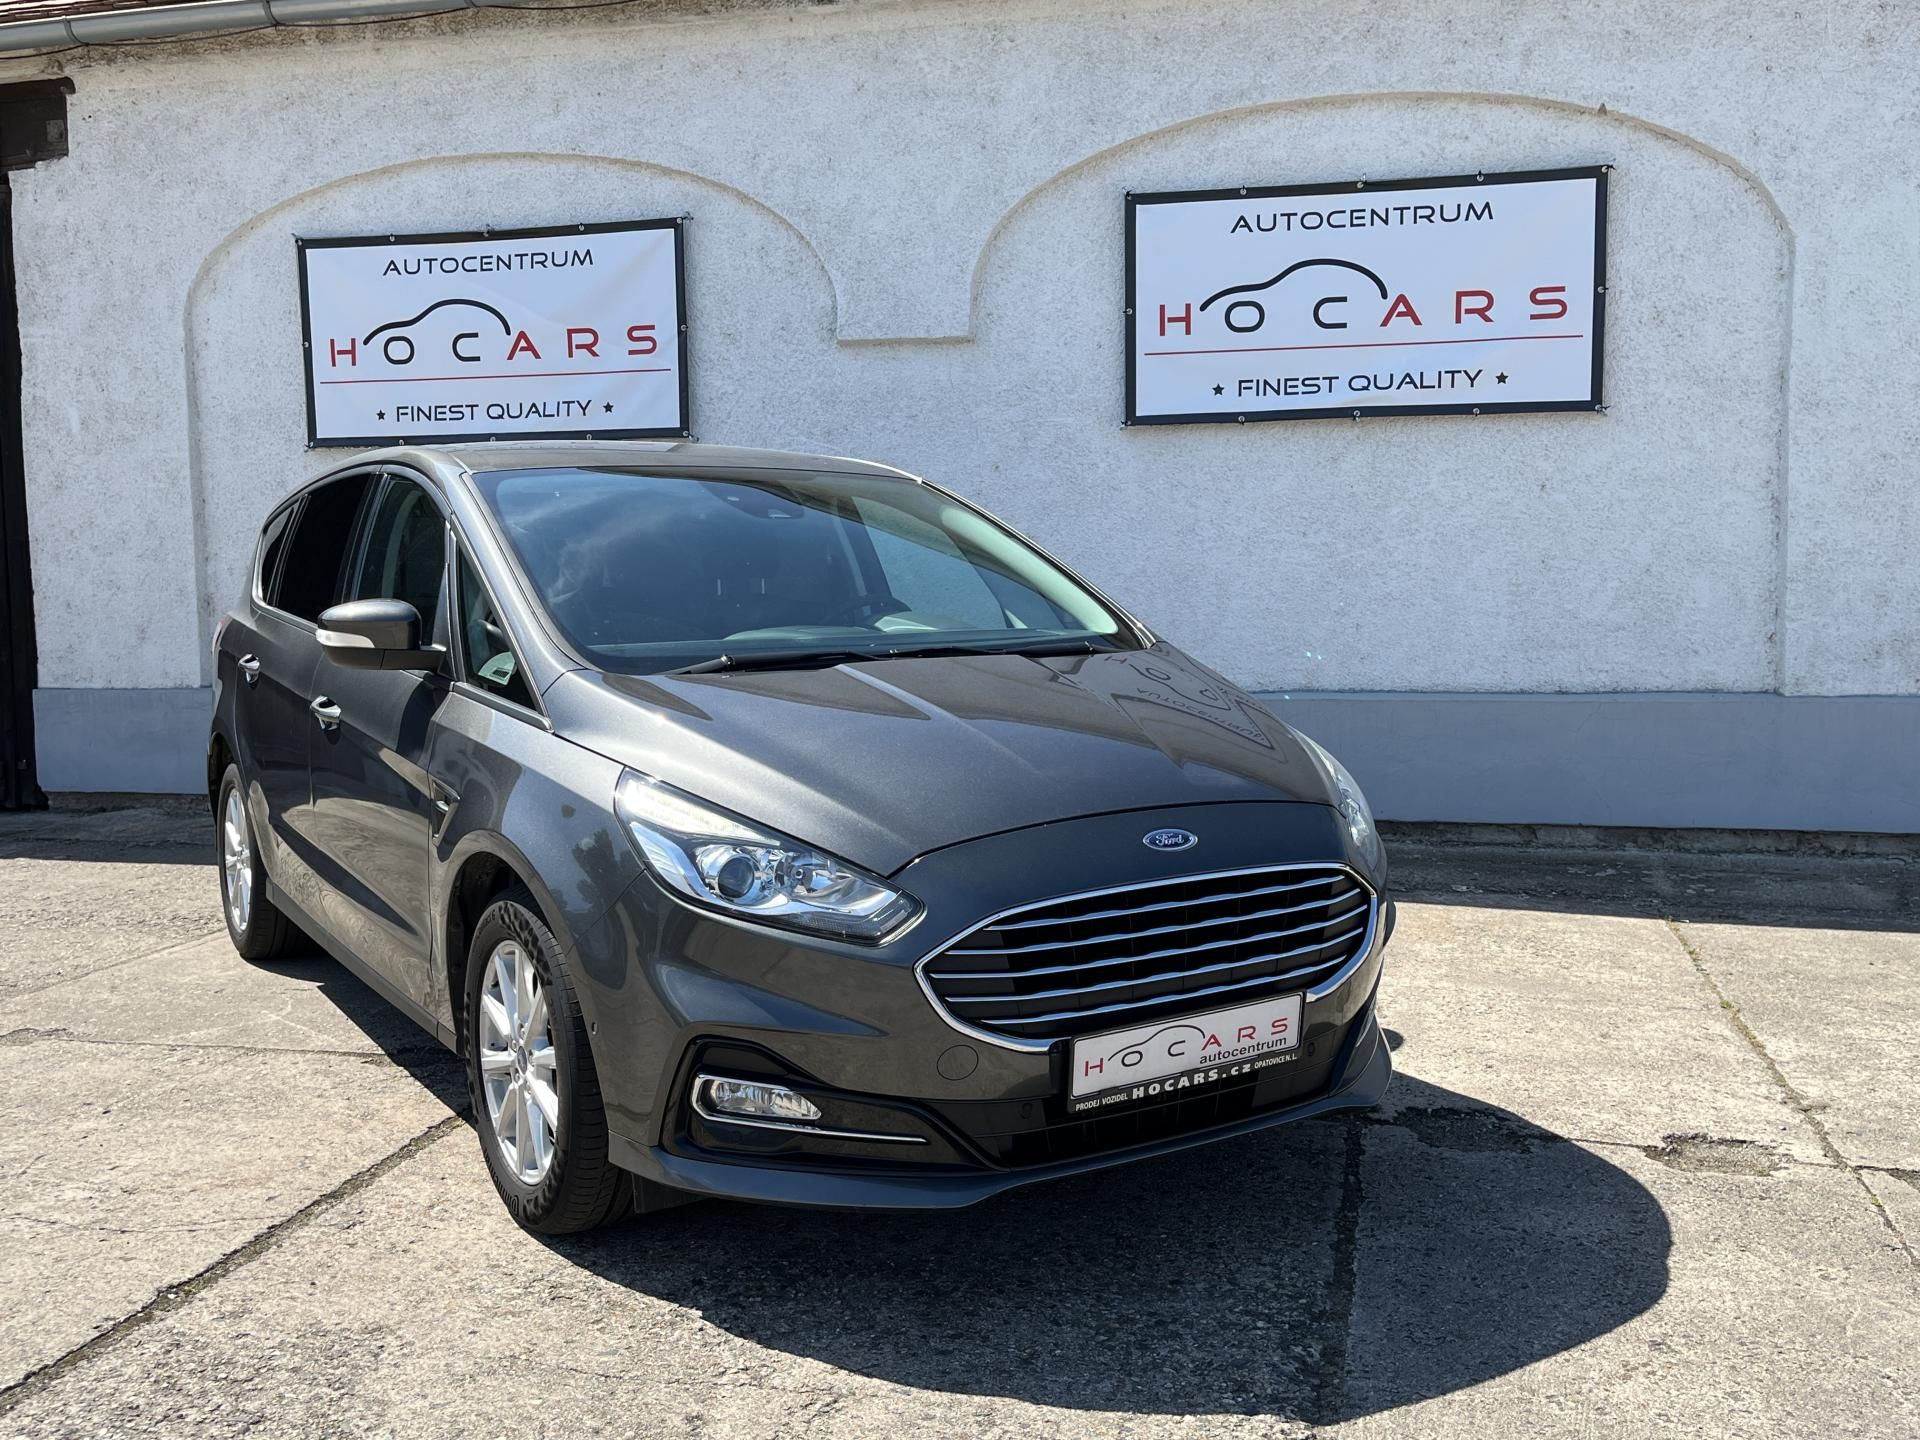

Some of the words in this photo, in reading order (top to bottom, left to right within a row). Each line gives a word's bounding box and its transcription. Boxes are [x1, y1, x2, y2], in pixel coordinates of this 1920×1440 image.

[1230, 201, 1494, 234] AUTOCENTRUM
[383, 249, 594, 276] AUTOCENTRUM
[1158, 285, 1568, 337] HOCARS
[329, 324, 658, 368] HOCARS
[1237, 375, 1340, 398] FINEST
[1347, 368, 1484, 393] QUALITY
[395, 403, 480, 423] FINEST
[486, 399, 593, 420] QUALITY
[1155, 833, 1185, 846] Ford
[1084, 1017, 1289, 1077] HOCARS
[1199, 1037, 1287, 1065] autocentrum
[1075, 1099, 1100, 1112] PRODEJ
[1102, 1092, 1128, 1105] VOZIDEL
[1254, 1055, 1286, 1070] OPATOVICE
